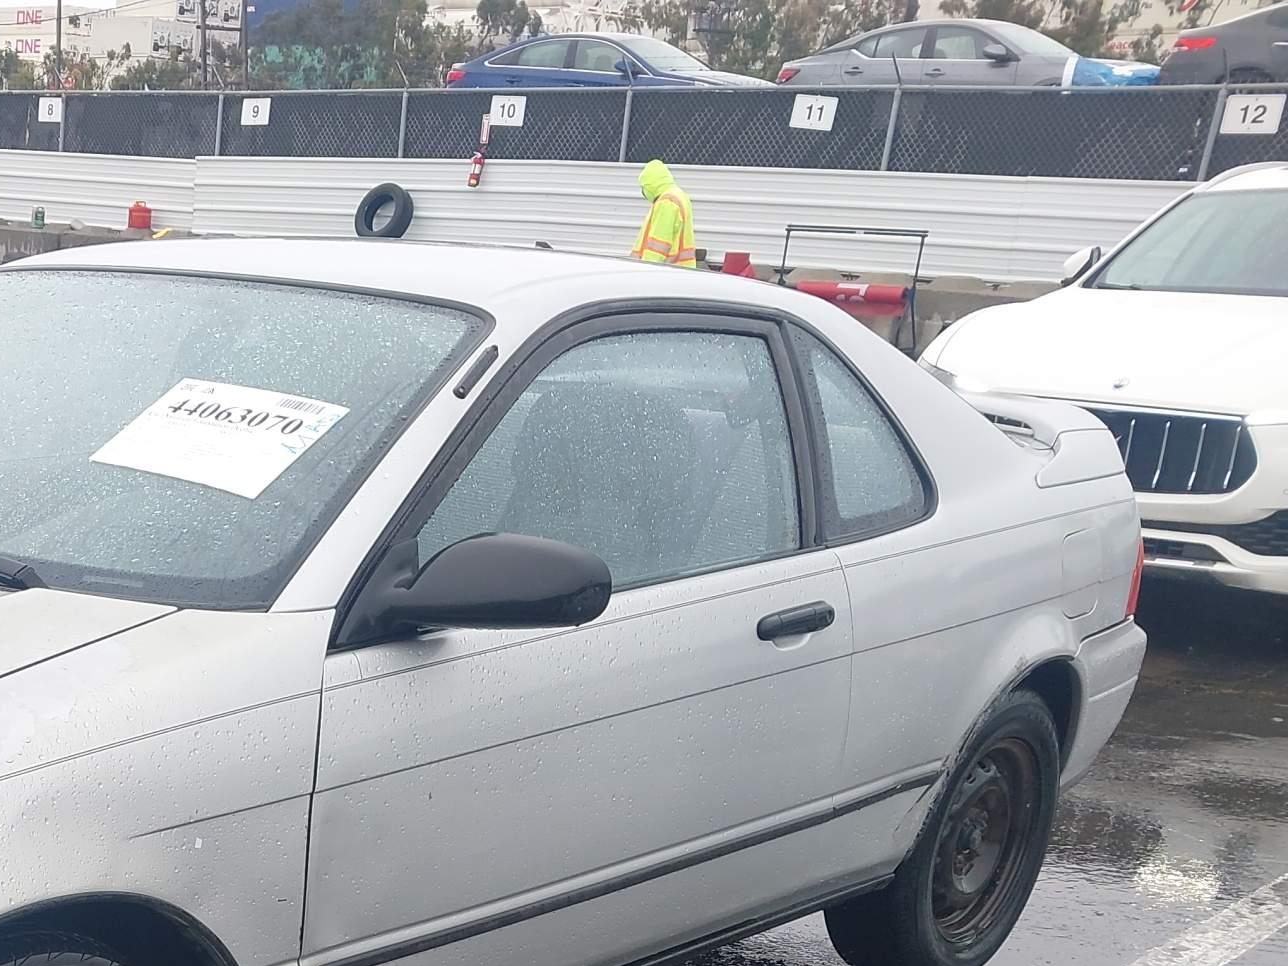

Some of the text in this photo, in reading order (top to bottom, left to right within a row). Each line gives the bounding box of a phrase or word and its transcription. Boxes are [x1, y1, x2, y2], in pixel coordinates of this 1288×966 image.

[16, 10, 42, 25] ONE
[16, 39, 41, 54] ONE
[47, 103, 54, 116] 8
[252, 104, 260, 119] 9
[499, 103, 516, 119] 10
[806, 103, 825, 122] 11
[1240, 104, 1268, 125] 12
[168, 399, 304, 435] 44063070
